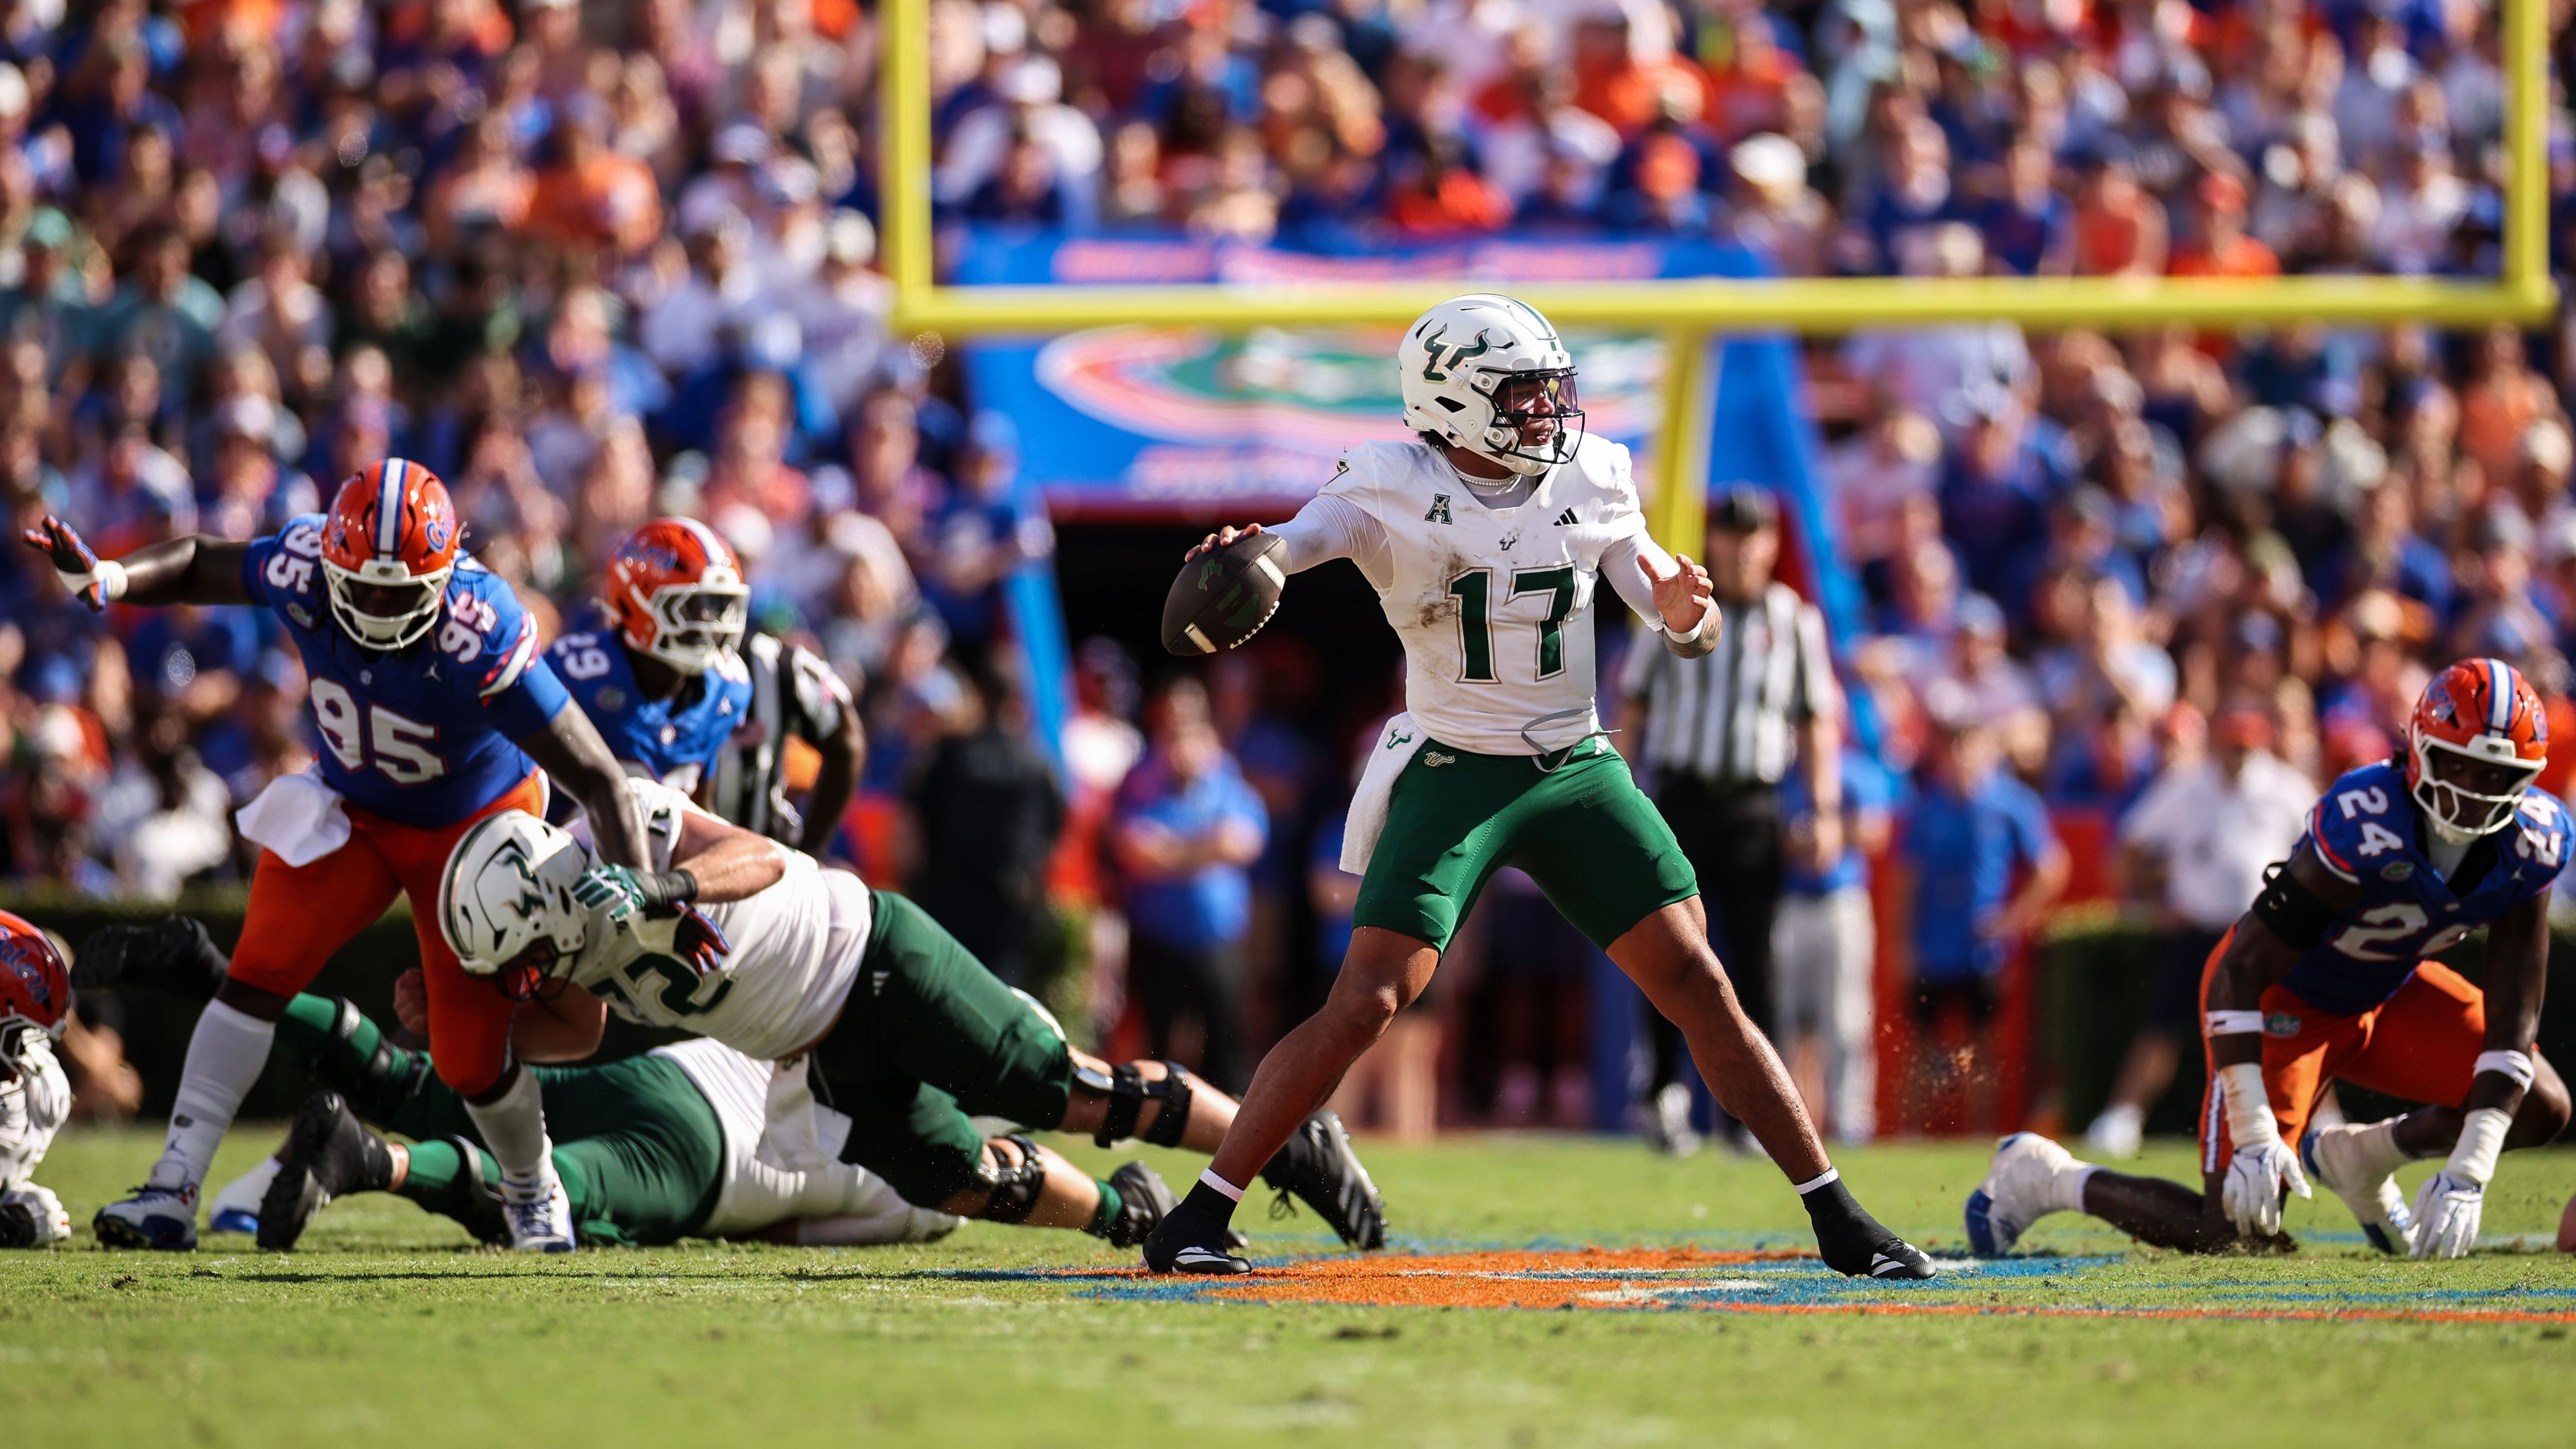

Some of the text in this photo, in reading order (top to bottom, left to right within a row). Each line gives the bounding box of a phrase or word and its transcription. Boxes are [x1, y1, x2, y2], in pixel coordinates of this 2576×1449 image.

[266, 524, 323, 595] 95
[439, 590, 498, 664] 95
[1444, 560, 1580, 685] 17
[309, 674, 450, 787] 95
[2336, 785, 2404, 858] 24
[2515, 794, 2562, 868] 24
